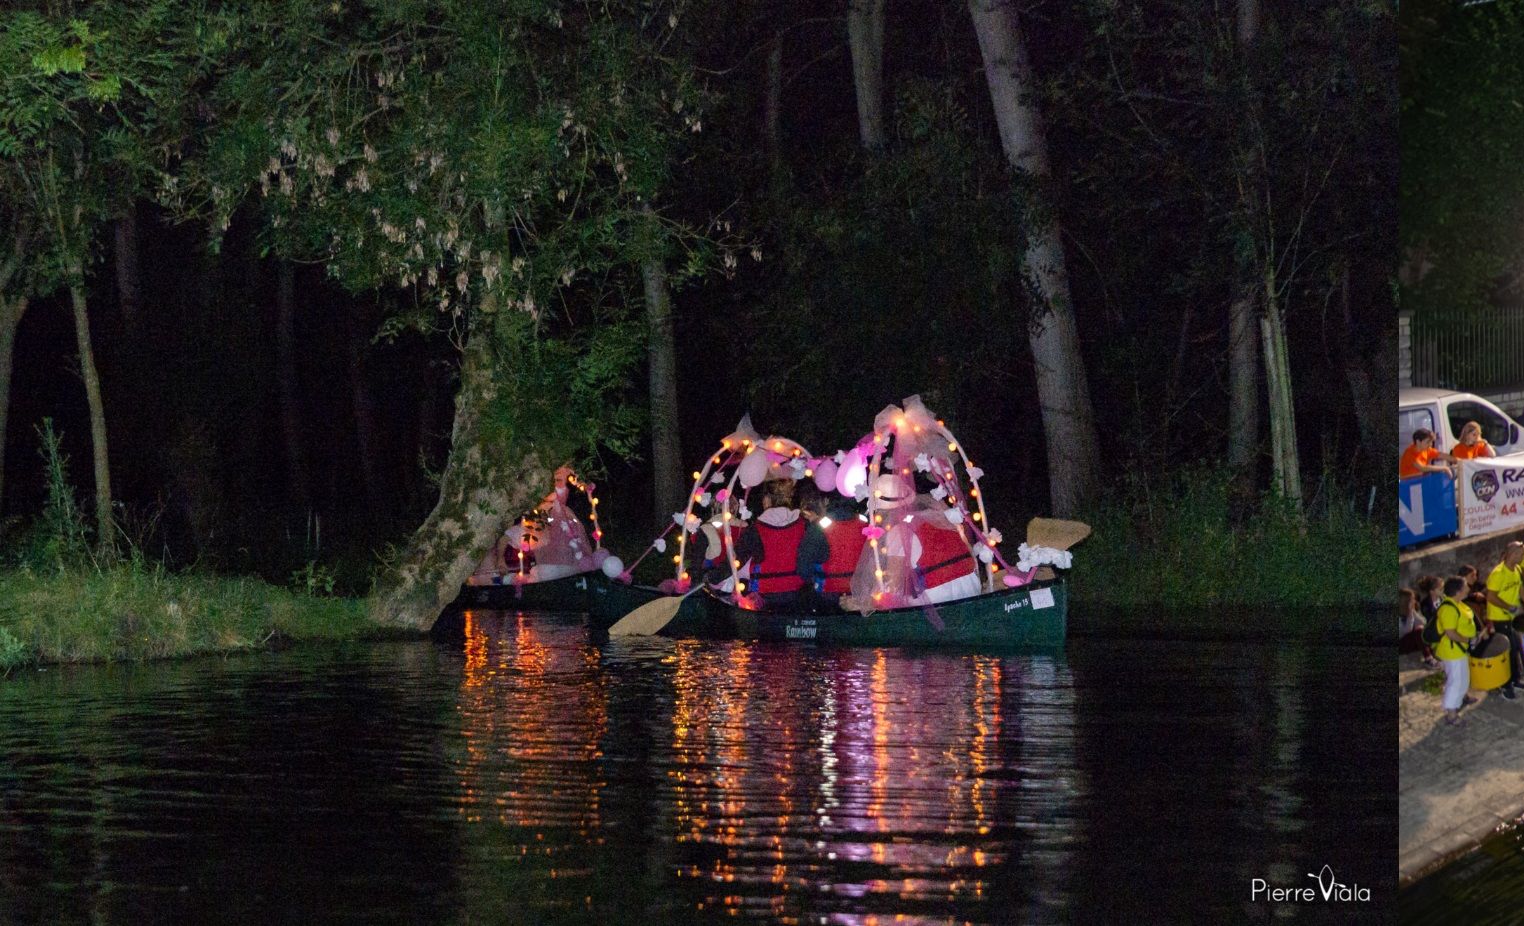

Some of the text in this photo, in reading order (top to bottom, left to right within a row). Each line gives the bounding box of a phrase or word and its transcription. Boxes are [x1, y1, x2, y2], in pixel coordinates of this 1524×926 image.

[1477, 484, 1496, 497] CKN
[1501, 502, 1517, 516] 44
[786, 625, 817, 638] Rainbow
